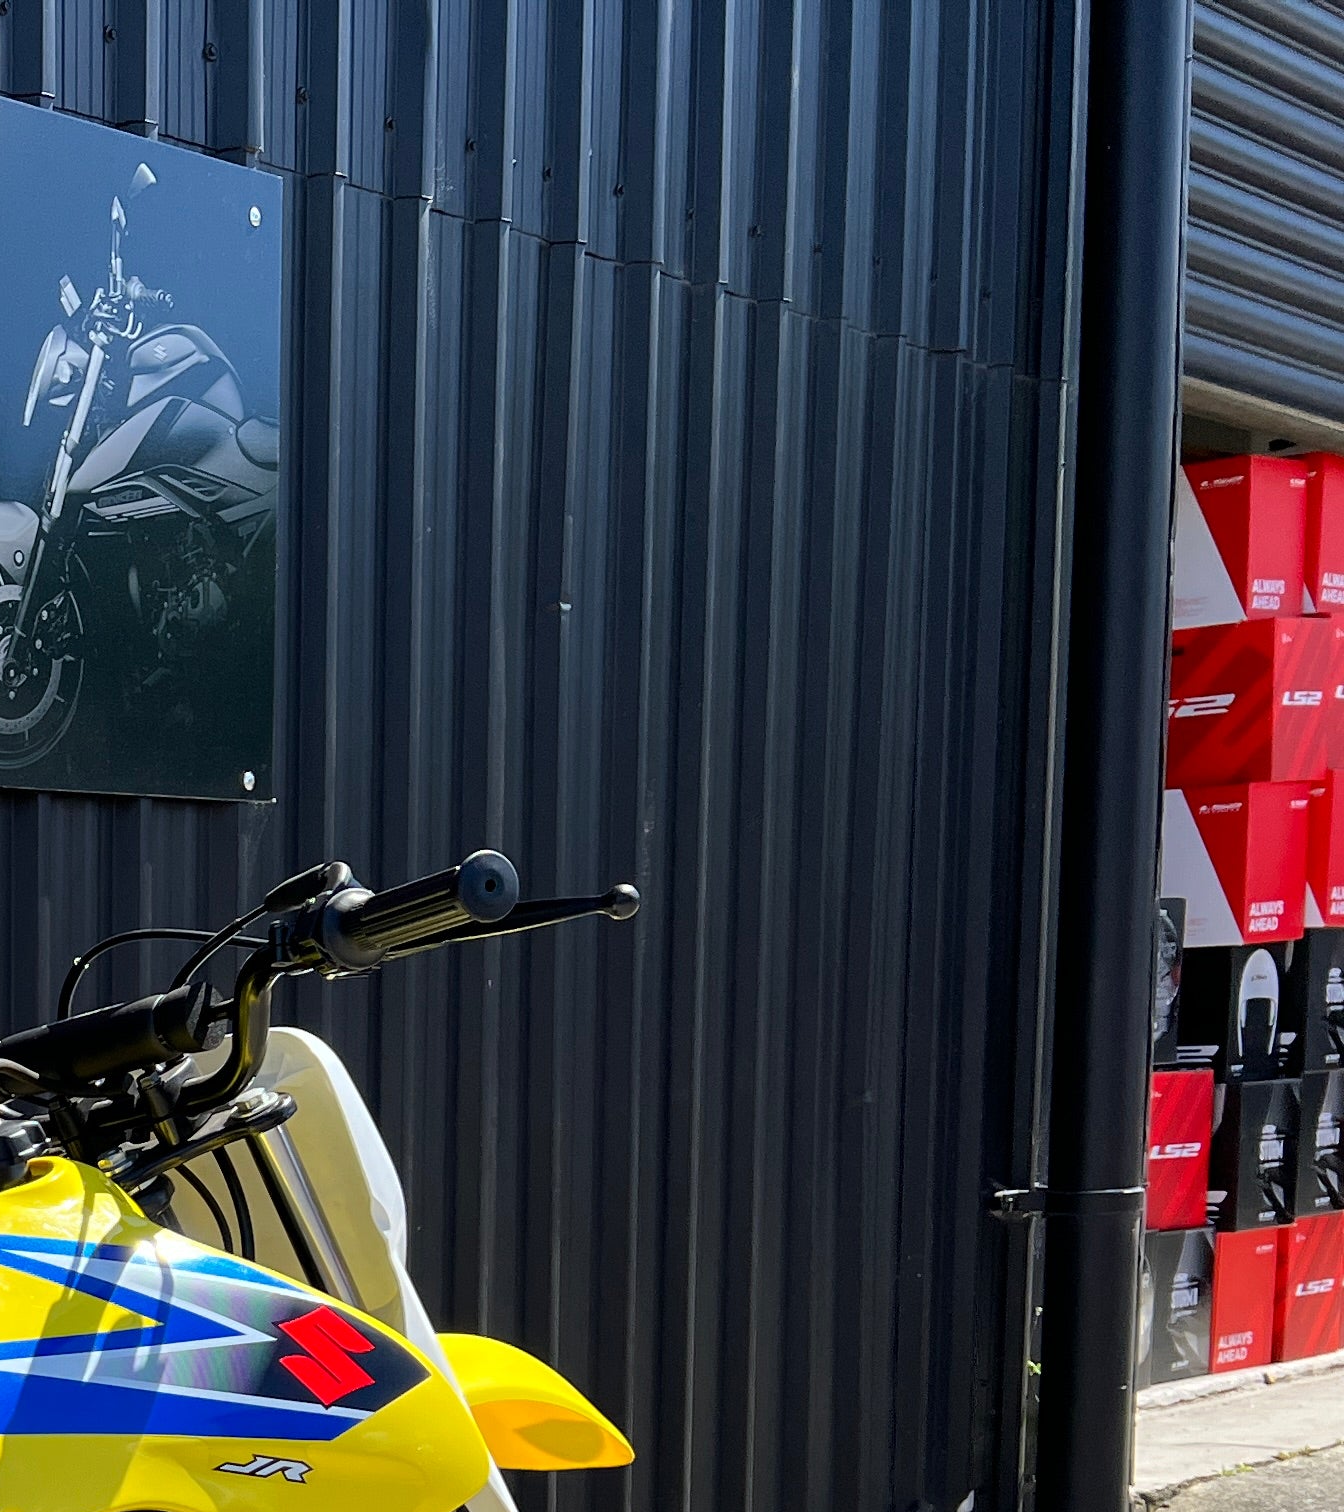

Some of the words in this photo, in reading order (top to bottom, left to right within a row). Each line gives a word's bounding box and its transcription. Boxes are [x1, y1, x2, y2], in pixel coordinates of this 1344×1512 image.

[1251, 578, 1286, 595] ALWAYS
[1251, 595, 1281, 610] AHEAD
[1281, 690, 1323, 706] LS2
[1248, 900, 1285, 917] ALWAYS
[1248, 917, 1279, 933] AHEAD
[1148, 1142, 1202, 1160] LS2
[1294, 1278, 1335, 1297] LS2
[1217, 1331, 1254, 1349] ALWAYS
[1216, 1347, 1248, 1365] AHEAD
[213, 1453, 314, 1485] JR
